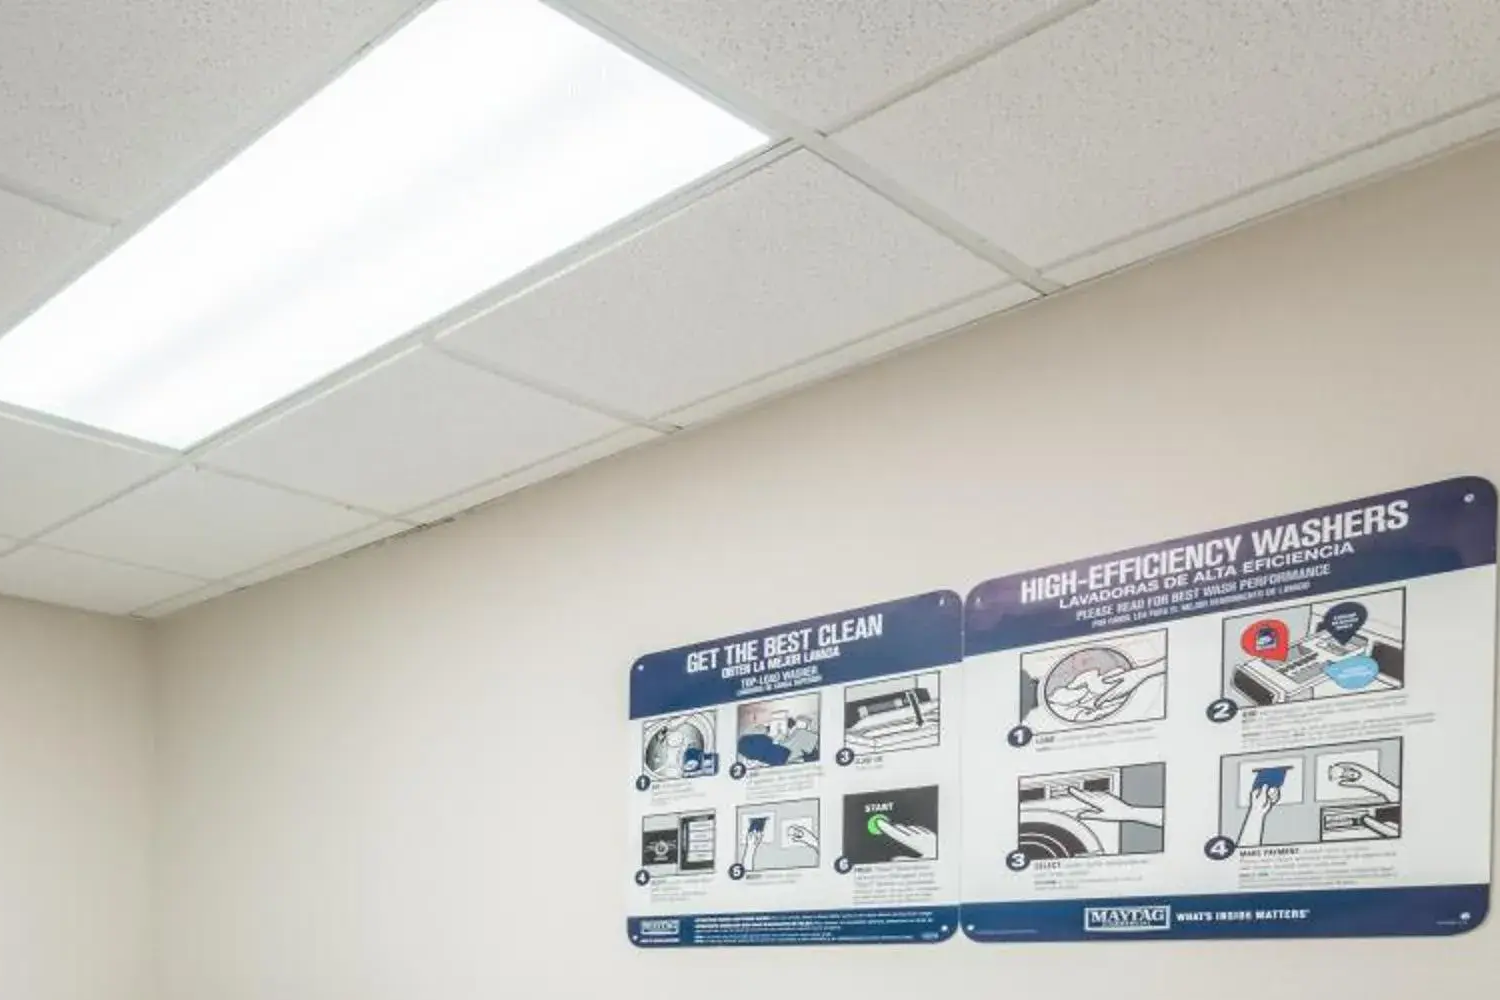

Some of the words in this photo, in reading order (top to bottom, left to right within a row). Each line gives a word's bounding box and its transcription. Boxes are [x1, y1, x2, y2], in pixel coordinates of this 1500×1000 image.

[1020, 534, 1242, 604] HIGH-EFFICIENCY
[1251, 499, 1409, 557] WASHERS
[1059, 580, 1160, 609] LAVADORAS
[1163, 573, 1189, 589] DE
[1193, 565, 1238, 583] ALTA
[1242, 541, 1356, 574] EFICIENCIA
[1075, 605, 1114, 621] PLEASE
[1116, 598, 1145, 614] READ
[1148, 593, 1169, 608] FOR
[1171, 587, 1199, 603] BEST
[1203, 581, 1237, 597] WASH
[1239, 563, 1332, 591] PERFORMANCE
[687, 648, 720, 673] GET
[724, 640, 759, 665] THE
[763, 629, 812, 658] BEST
[817, 613, 884, 647] CLEAN
[1214, 703, 1229, 718] 2
[1014, 729, 1024, 743] 1
[864, 802, 894, 813] START
[1211, 840, 1228, 855] 4
[1011, 853, 1025, 868] 3
[1091, 909, 1164, 923] MAYTAG
